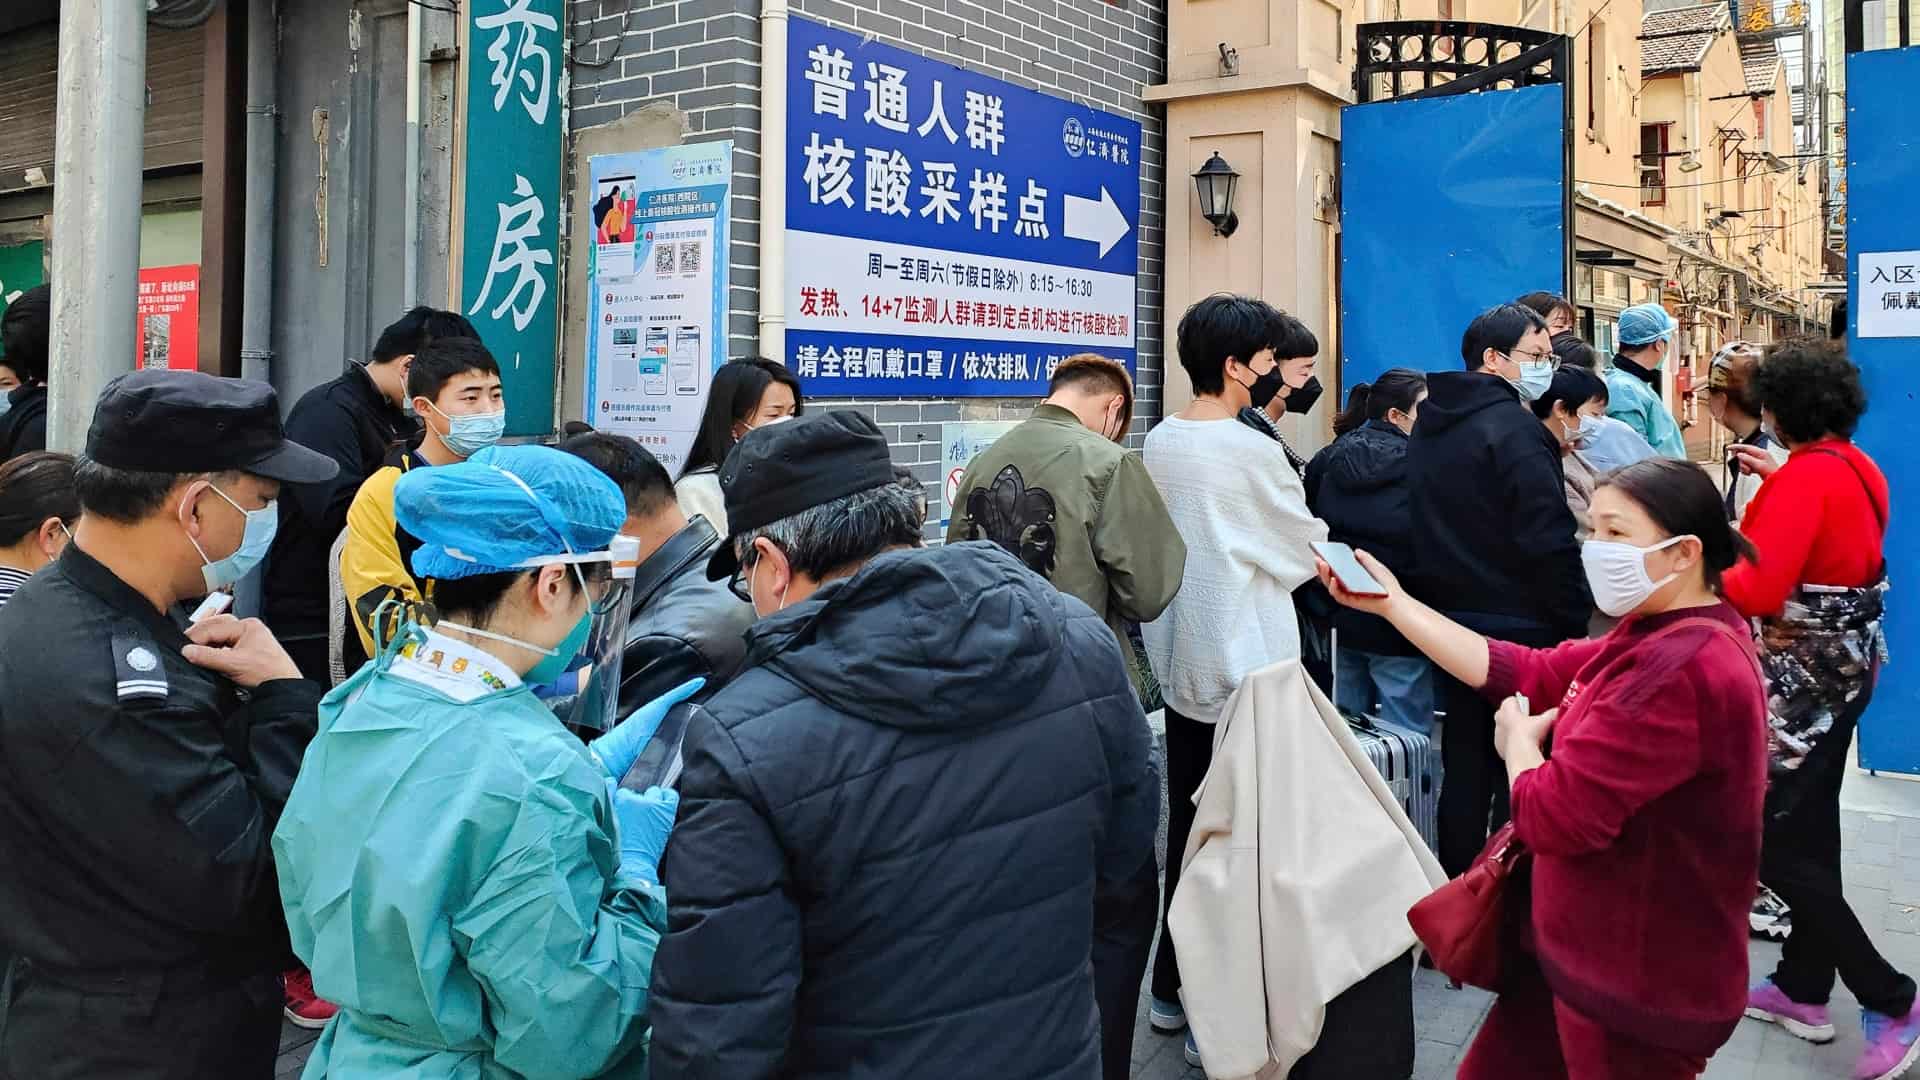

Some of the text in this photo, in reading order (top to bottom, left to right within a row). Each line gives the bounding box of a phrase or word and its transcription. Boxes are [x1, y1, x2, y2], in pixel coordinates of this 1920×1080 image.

[804, 44, 1006, 156] 普通人群
[469, 0, 559, 333] 药房
[803, 132, 1050, 240] 核酸采样点
[799, 286, 1129, 337] 发热、14+7监测人群请到定点机构进行核酸检测
[1869, 264, 1920, 283] 入区
[796, 345, 945, 380] 请全程佩戴口罩
[962, 352, 1030, 381] 依次排队
